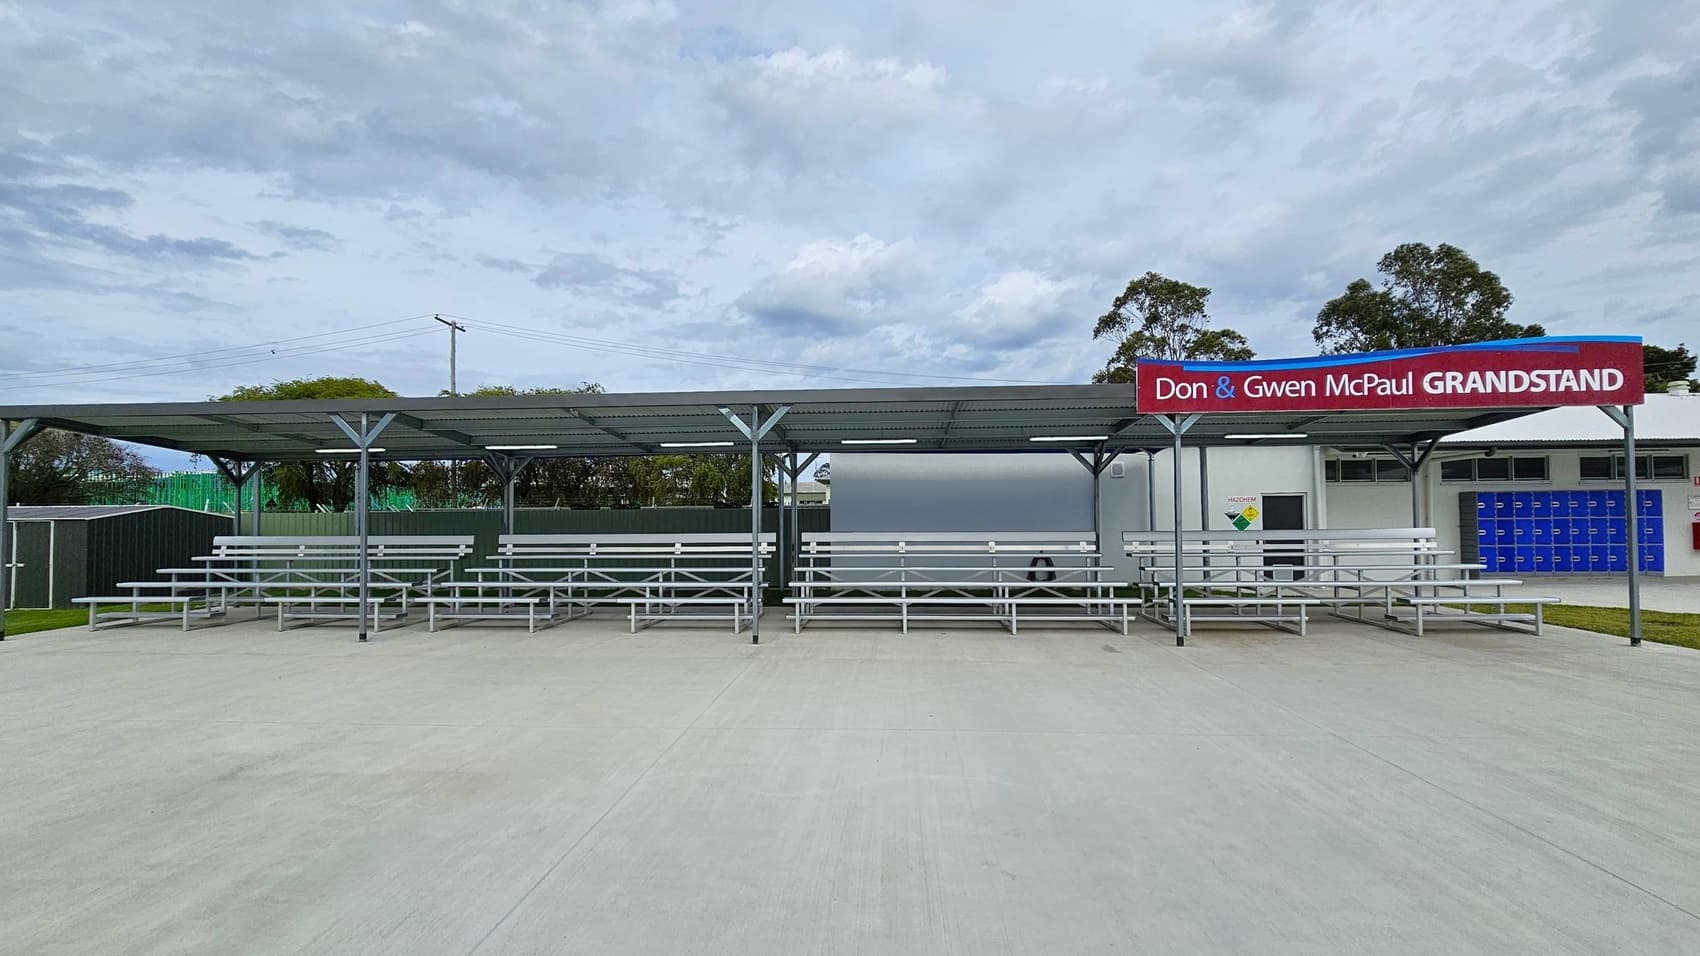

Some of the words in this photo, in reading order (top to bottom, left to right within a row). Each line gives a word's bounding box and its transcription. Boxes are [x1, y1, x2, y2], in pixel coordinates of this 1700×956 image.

[1156, 377, 1208, 400] Don
[1216, 376, 1236, 399] &
[1243, 375, 1316, 398] Gwen
[1325, 371, 1413, 397] McPaul
[1422, 368, 1624, 394] GRANDSTAND
